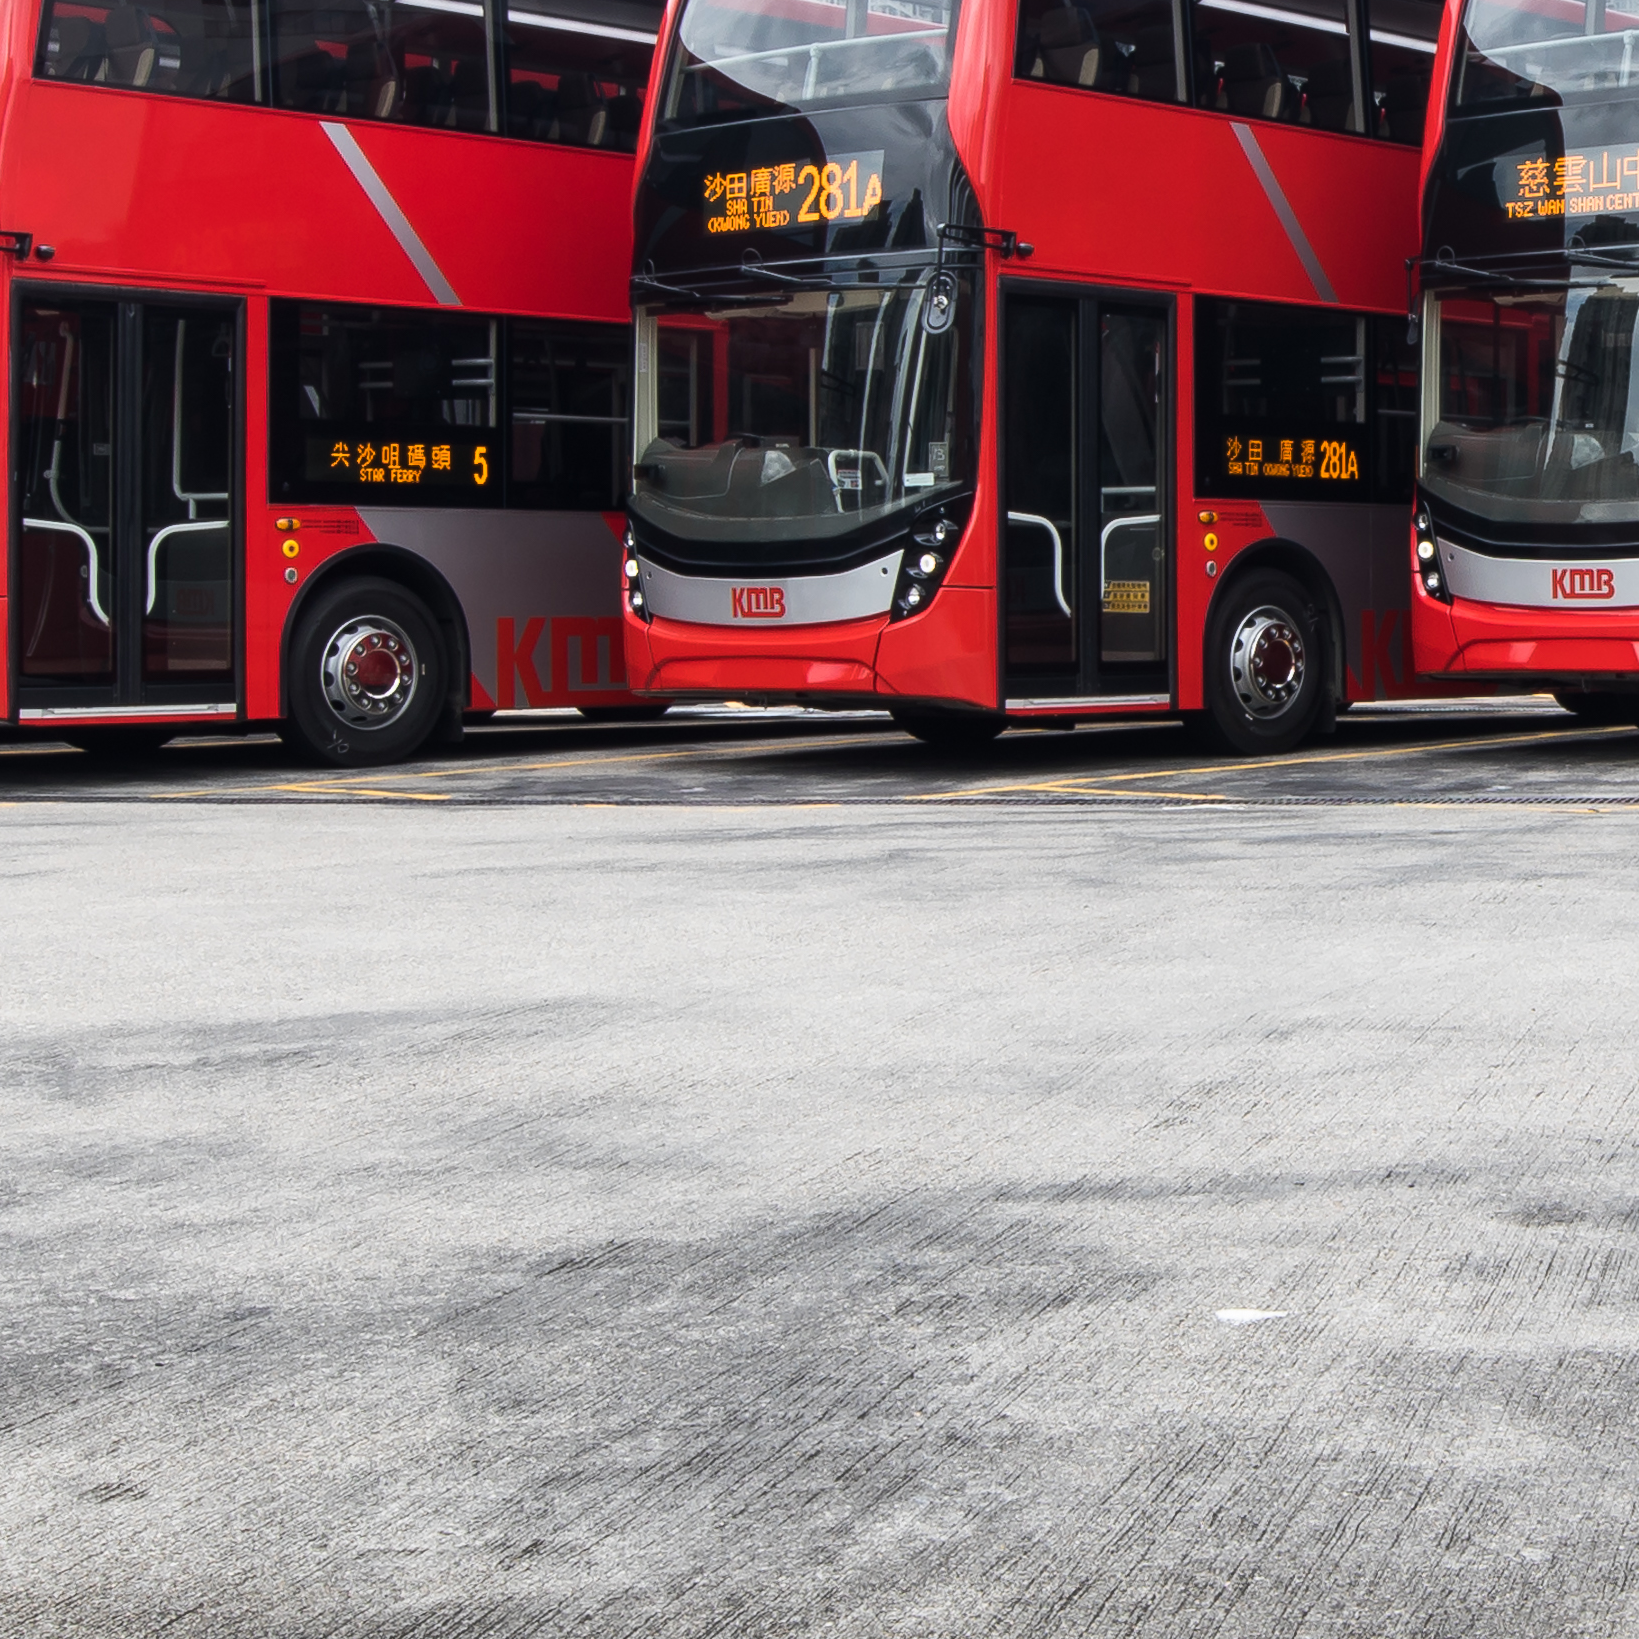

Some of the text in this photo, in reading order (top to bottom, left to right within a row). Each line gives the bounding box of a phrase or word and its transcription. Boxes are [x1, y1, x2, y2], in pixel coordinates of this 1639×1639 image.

[726, 196, 773, 215] SHA TIN
[797, 160, 882, 223] 281A
[1505, 201, 1535, 218] TSZ
[1538, 199, 1565, 216] WAN
[1569, 195, 1604, 214] SHAN
[708, 210, 790, 233] (KWONG YUEN)
[330, 442, 451, 470] 尖沙咀碼頭
[473, 446, 488, 485] 5
[1320, 440, 1358, 479] 281A
[359, 468, 422, 483] STAR FERRY
[1552, 568, 1615, 600] KMB
[731, 587, 786, 619] KMB
[1361, 610, 1416, 700] K
